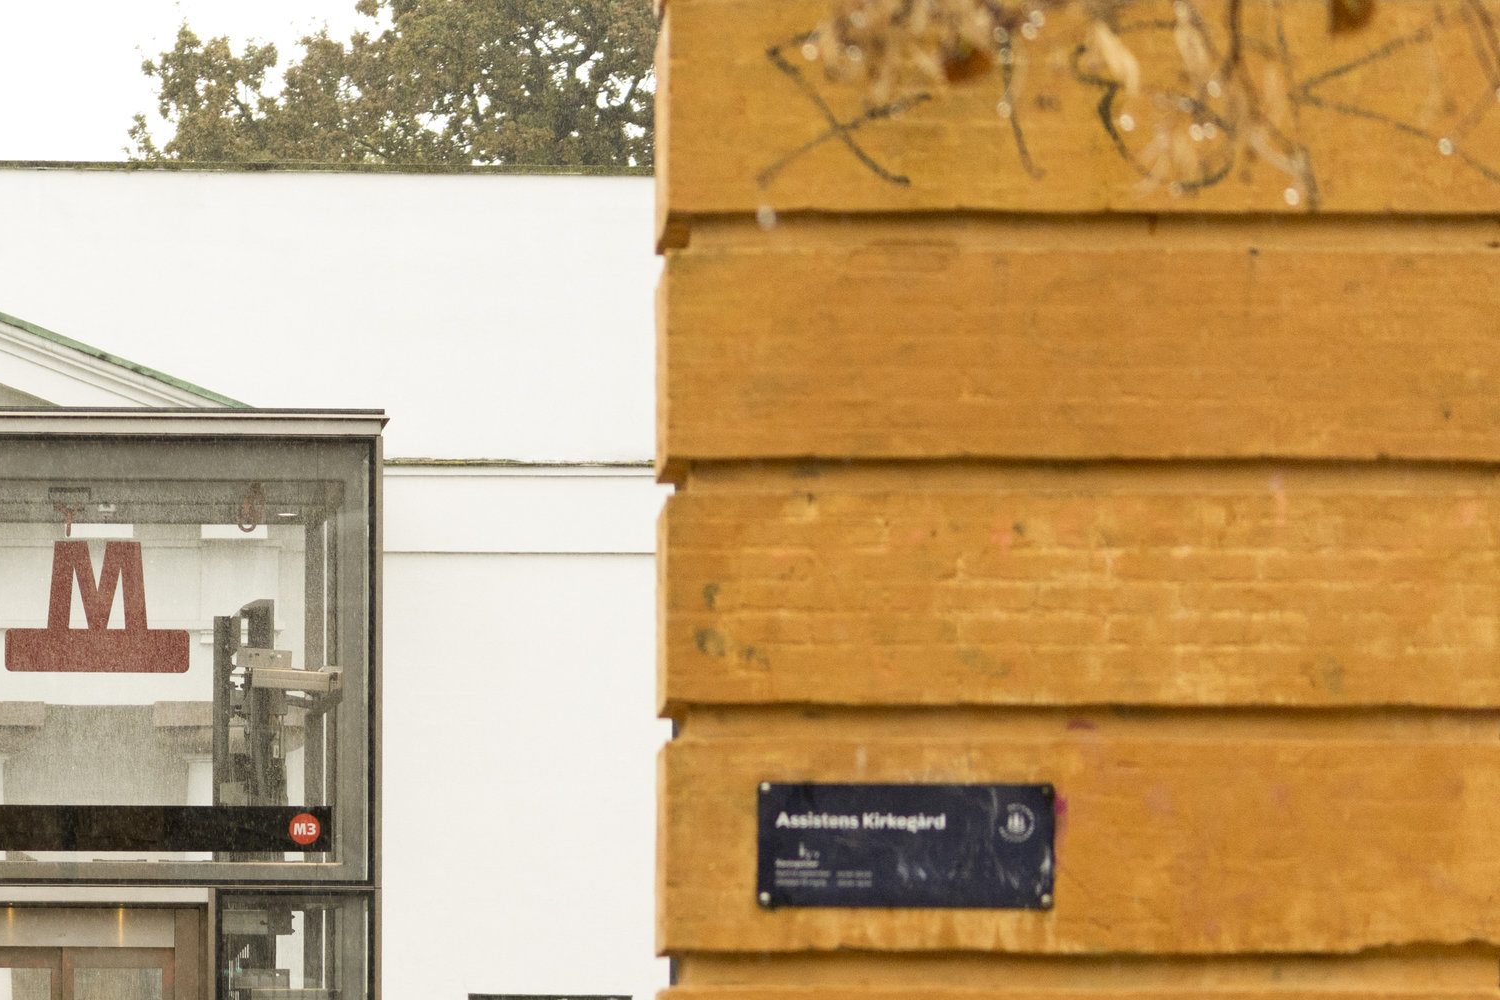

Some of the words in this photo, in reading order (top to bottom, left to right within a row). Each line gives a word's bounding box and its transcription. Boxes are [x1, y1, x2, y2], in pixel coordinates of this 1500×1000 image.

[293, 822, 317, 836] M3
[775, 811, 859, 829] Assistens
[863, 812, 946, 833] Kirkegård
